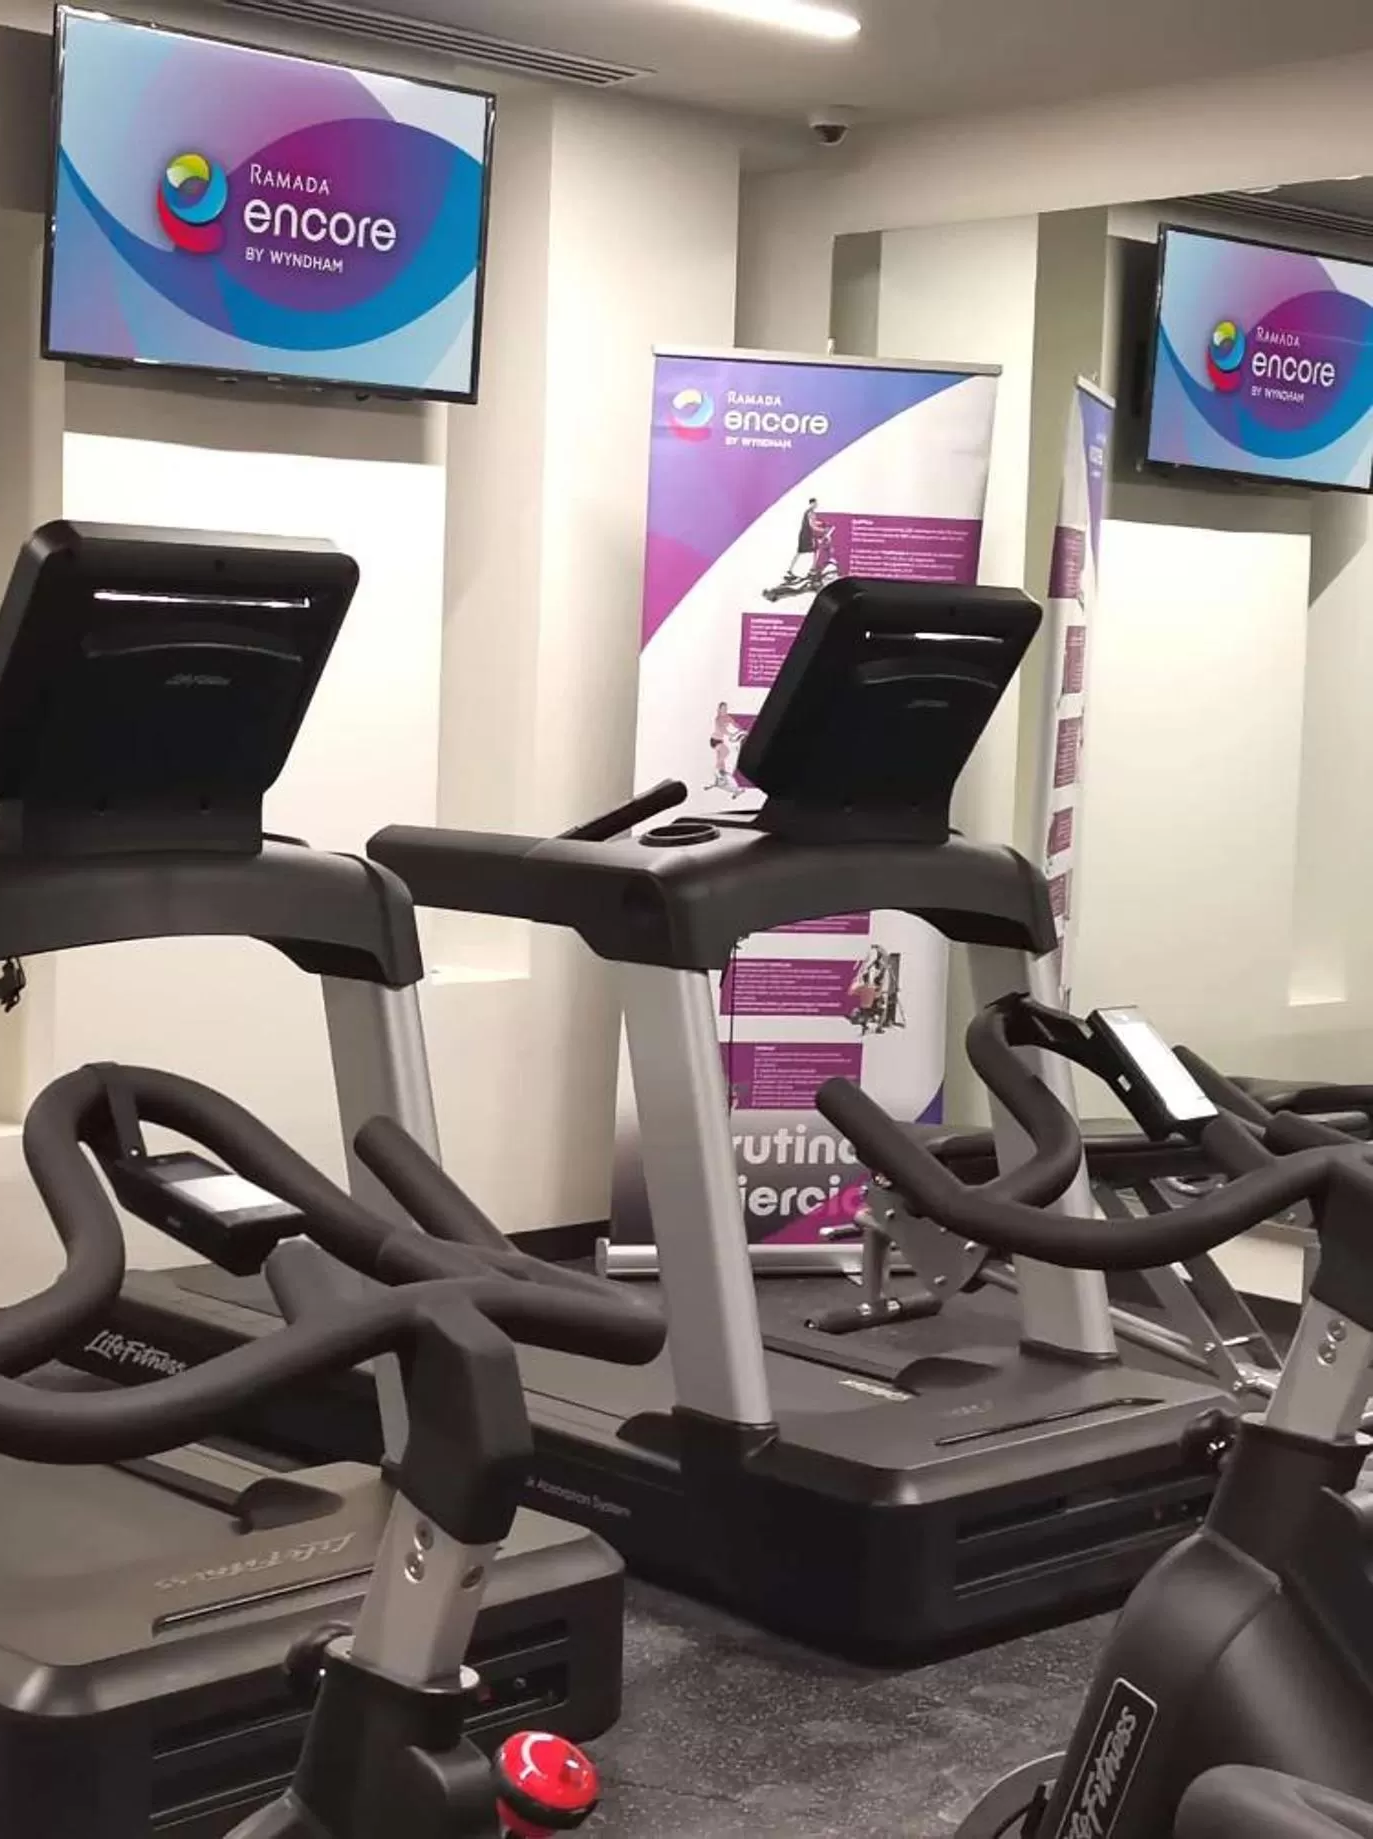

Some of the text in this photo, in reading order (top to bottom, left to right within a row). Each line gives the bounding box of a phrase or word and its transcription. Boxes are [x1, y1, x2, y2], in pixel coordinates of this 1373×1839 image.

[243, 198, 397, 252] encore
[245, 246, 344, 273] BY WYNDHAM
[1251, 351, 1336, 388] encore
[724, 410, 829, 436] encore
